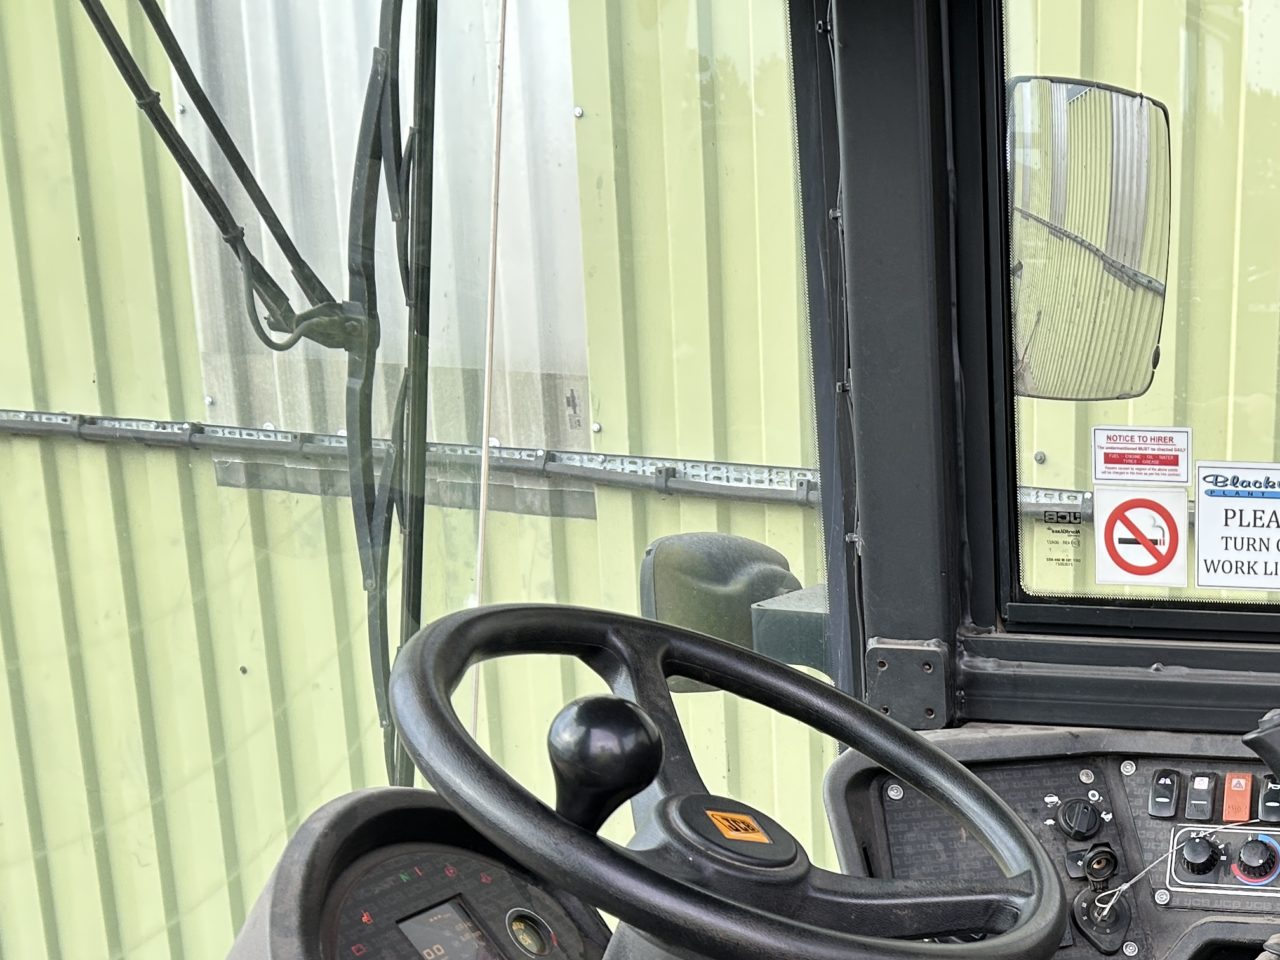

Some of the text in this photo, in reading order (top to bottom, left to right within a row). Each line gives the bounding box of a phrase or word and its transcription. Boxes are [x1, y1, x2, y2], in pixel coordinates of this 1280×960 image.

[1106, 434, 1174, 444] NOTICE TO HIRER
[1221, 536, 1270, 552] TURN
[1203, 559, 1258, 575] WORK
